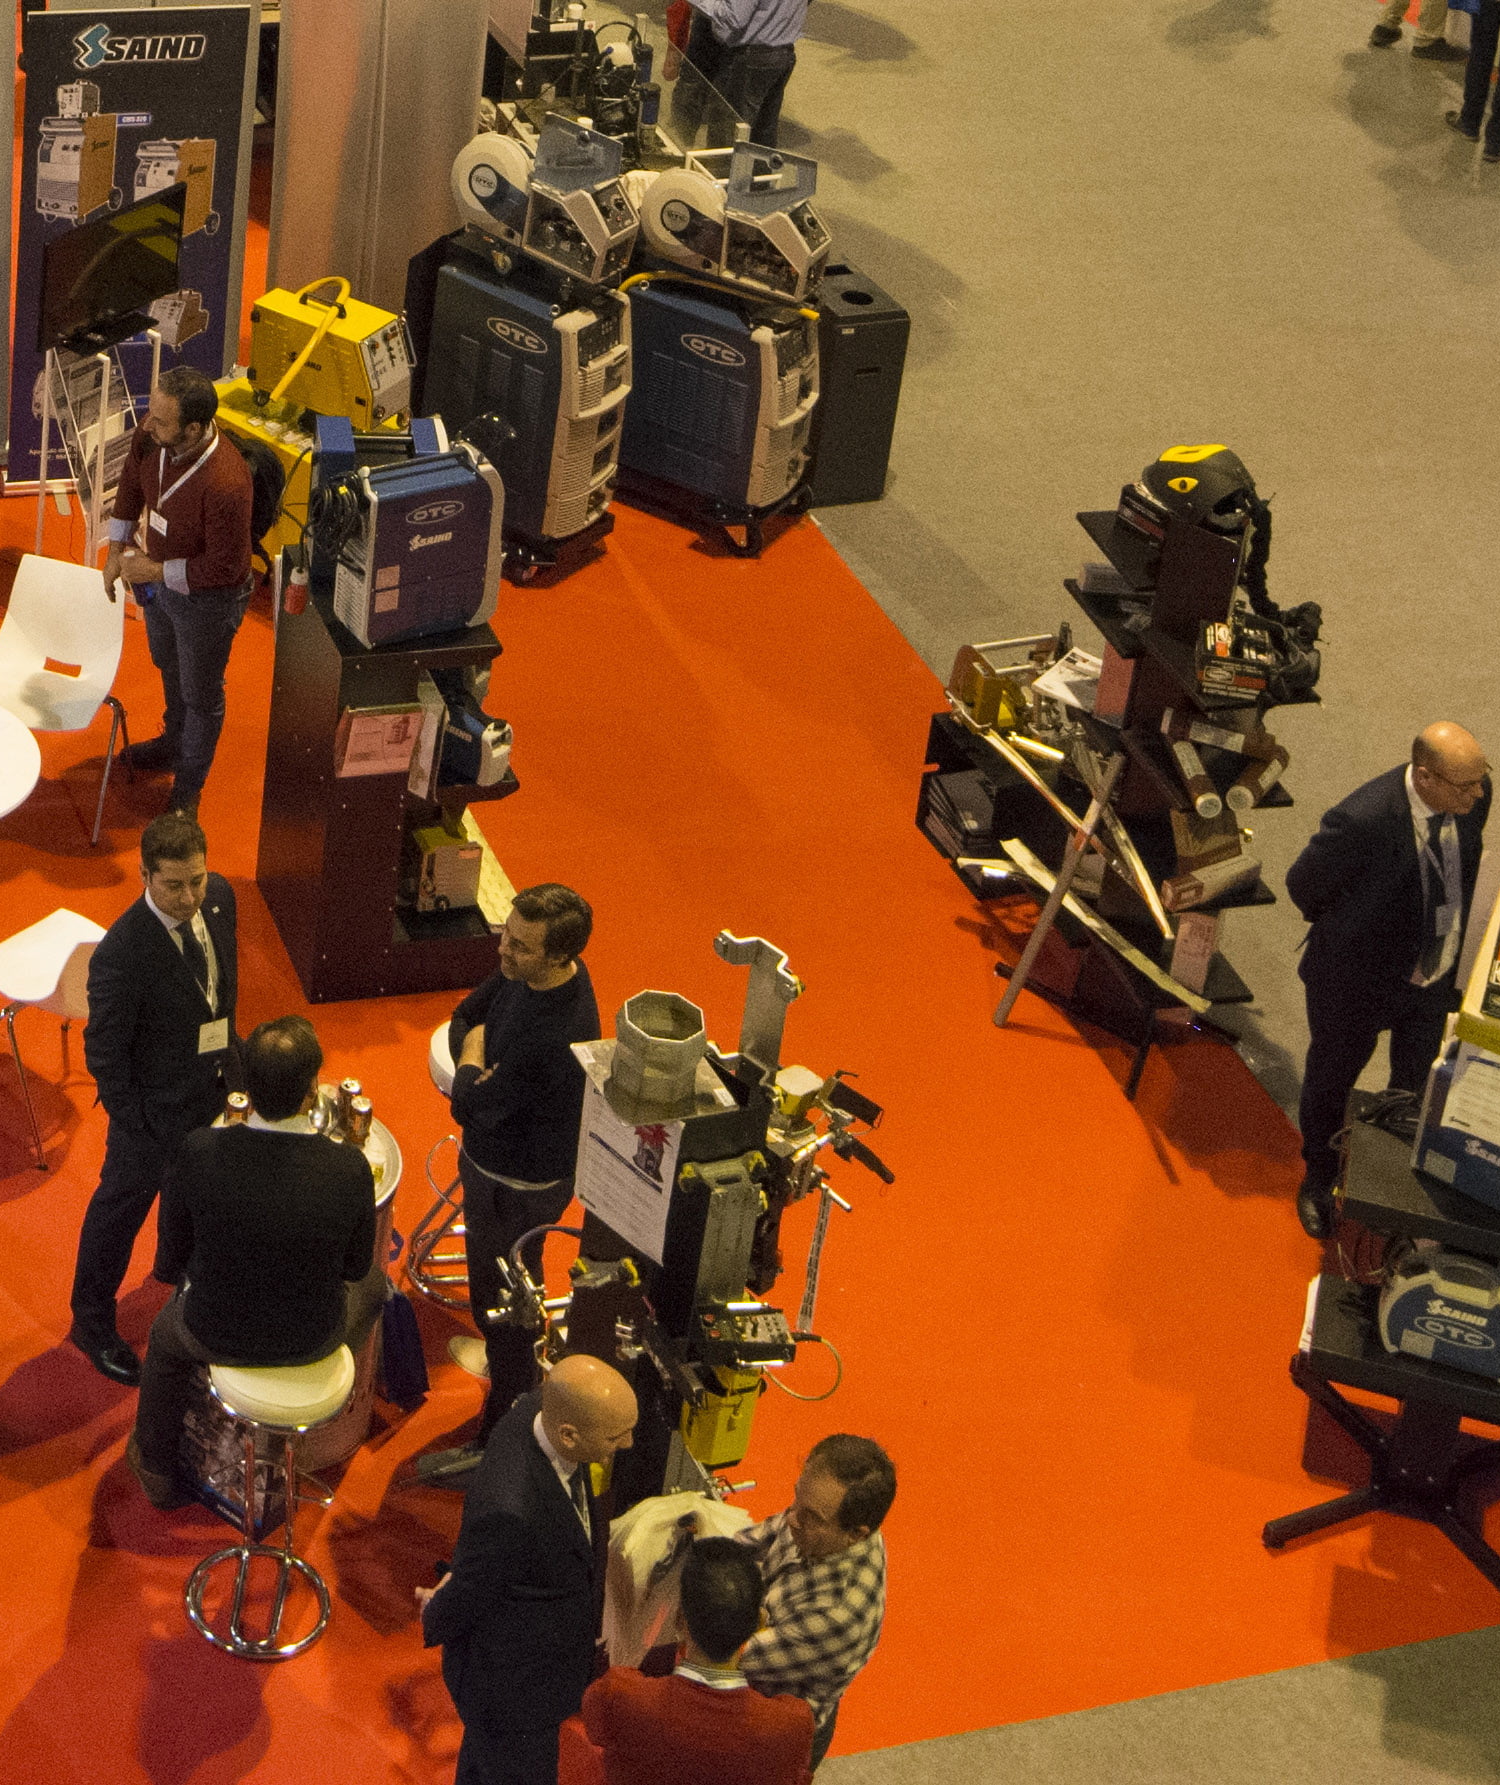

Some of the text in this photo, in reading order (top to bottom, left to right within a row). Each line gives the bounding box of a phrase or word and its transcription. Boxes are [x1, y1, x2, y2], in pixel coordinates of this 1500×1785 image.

[99, 31, 207, 66] SAIND
[494, 322, 541, 351] OTC
[689, 338, 741, 364] OTC
[410, 501, 459, 523] OTC
[1423, 1317, 1485, 1347] OTC
